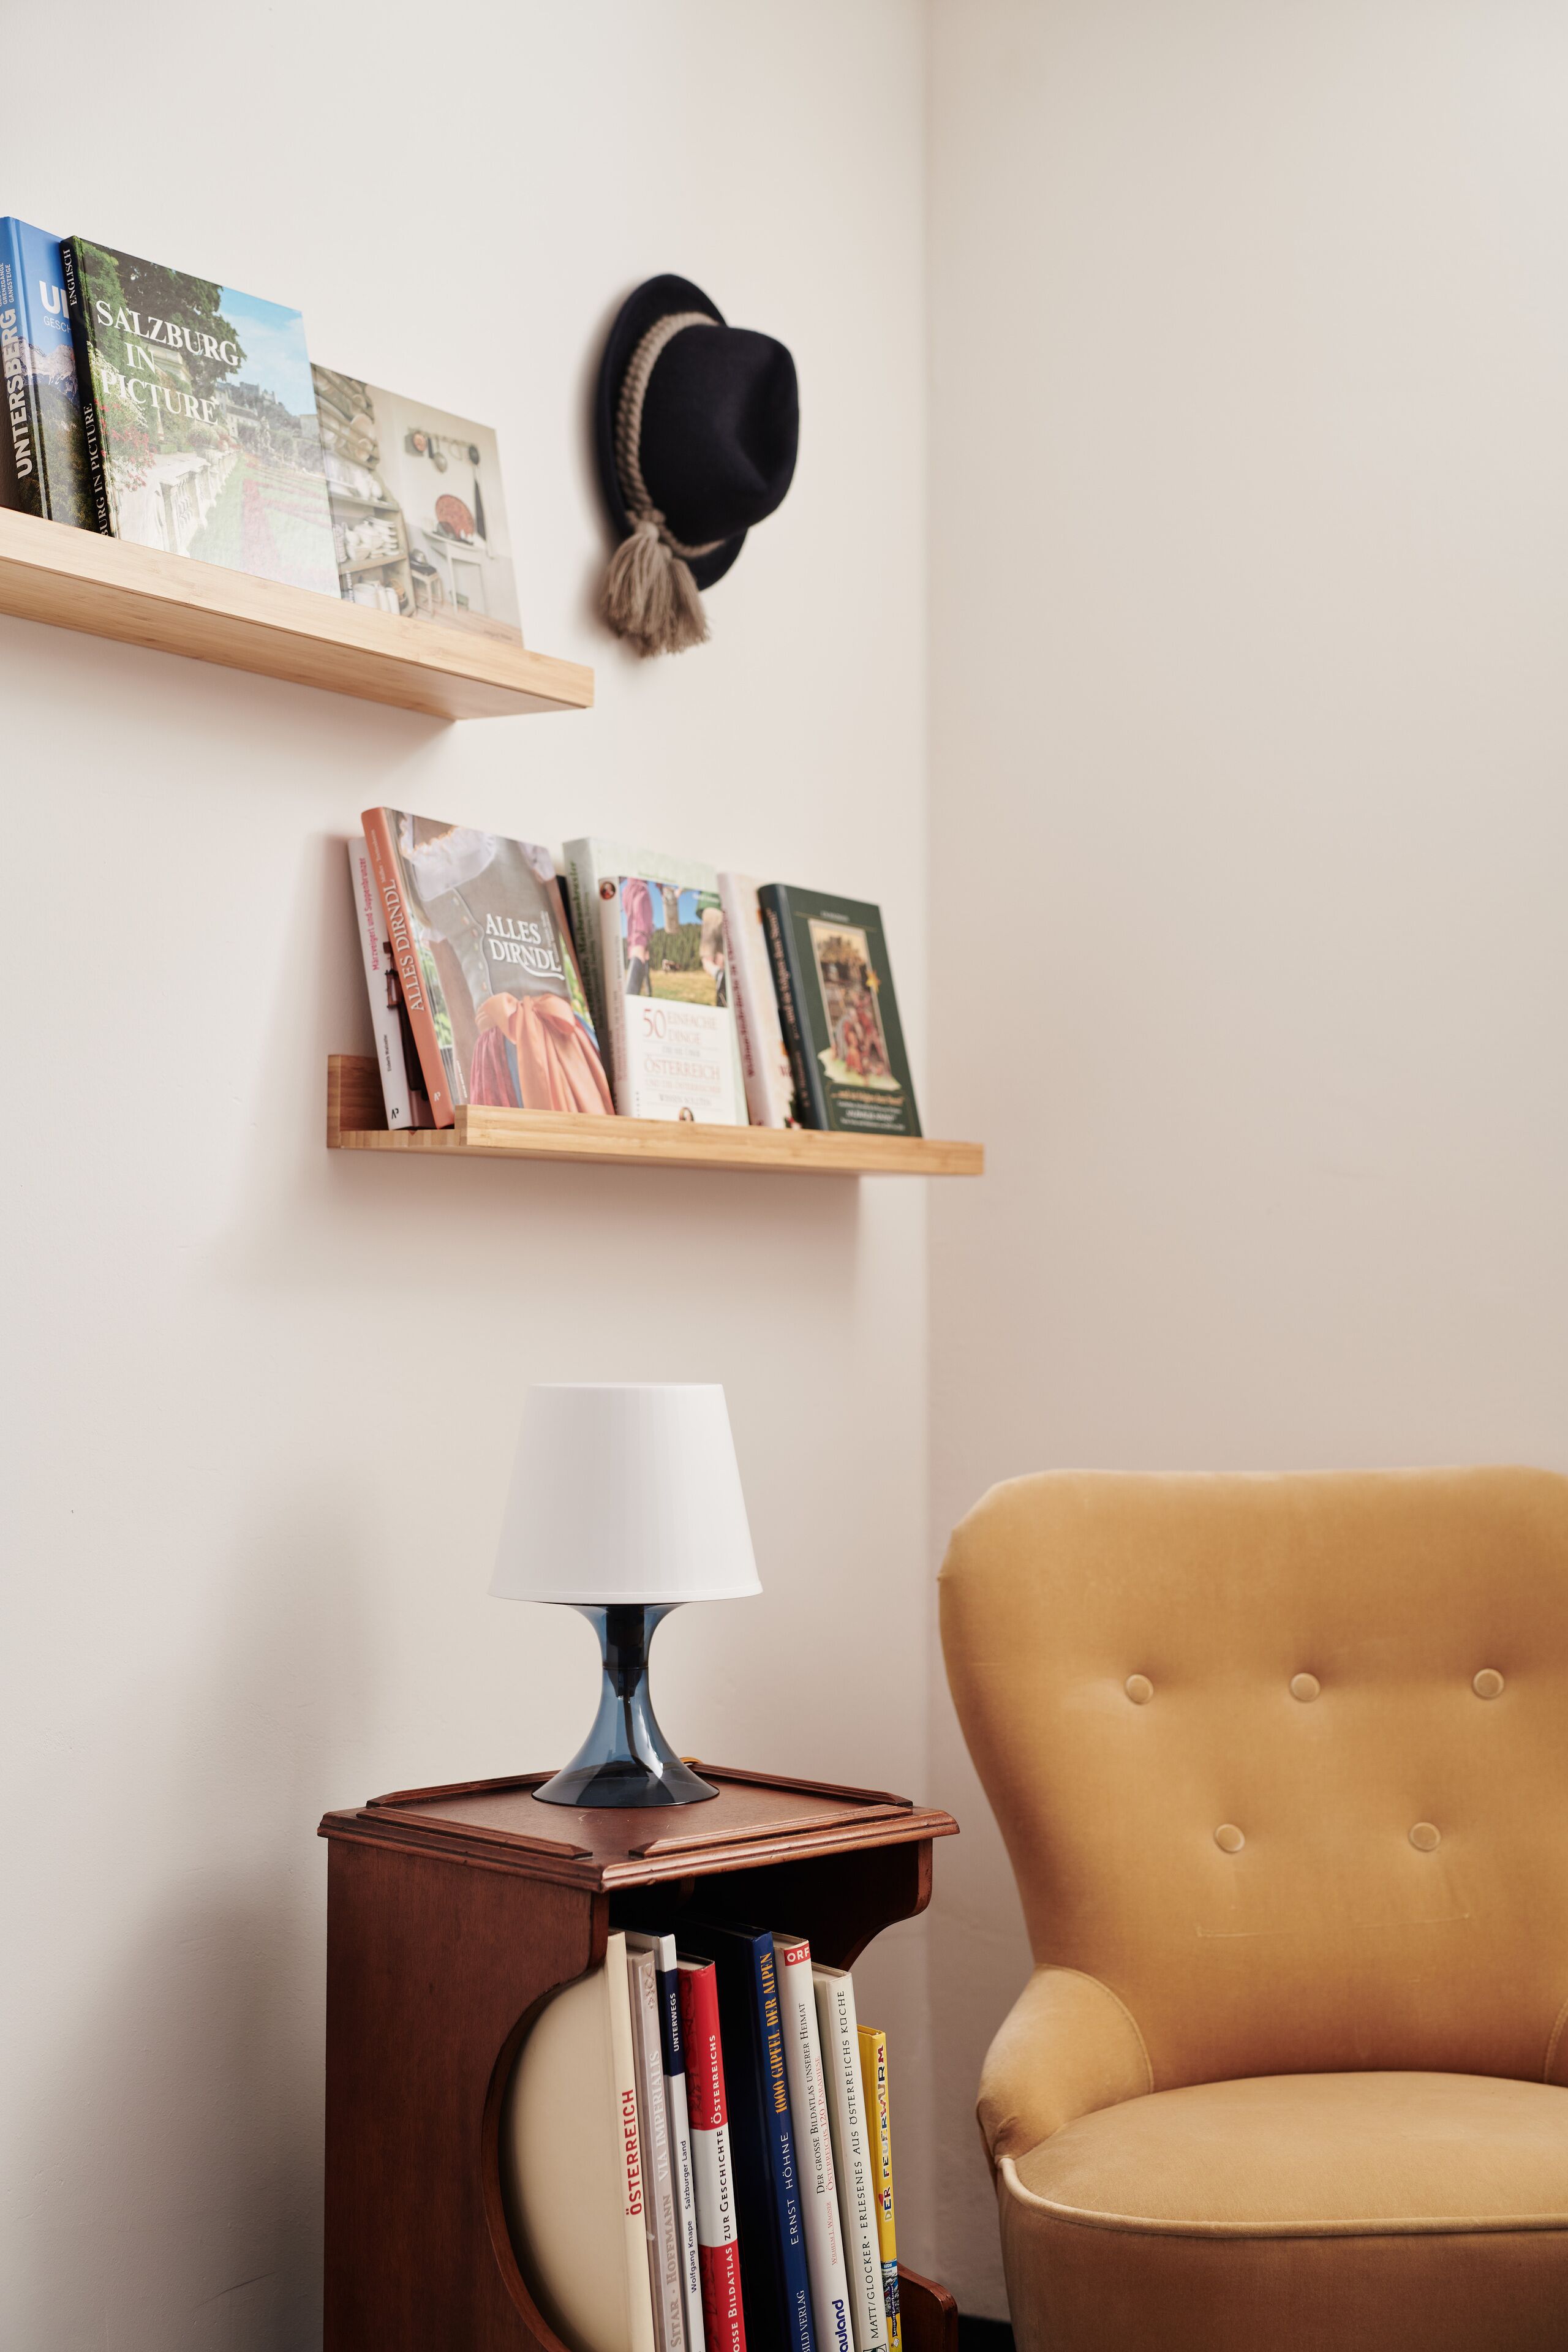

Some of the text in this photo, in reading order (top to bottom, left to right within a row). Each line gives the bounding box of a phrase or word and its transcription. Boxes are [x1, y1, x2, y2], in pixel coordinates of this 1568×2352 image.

[6, 264, 15, 303] GANGSTEIGE
[64, 249, 77, 306] ENGLISCH
[96, 300, 239, 366] SALZBURG
[124, 342, 156, 374] IN
[1, 308, 32, 480] UNTERSBERG
[100, 369, 219, 426] PICTURE
[83, 403, 100, 472] PICTURE
[92, 474, 104, 494] IN
[383, 879, 425, 1011] ALLES DIRNDL
[486, 913, 541, 945] ALLES
[488, 938, 565, 980] DIRNDL
[644, 1009, 666, 1039] 50
[644, 1053, 722, 1080] ÖSTERREICH
[786, 1947, 810, 1963] ORF
[670, 1992, 679, 2052] UNTERWEGS
[760, 1952, 788, 2114] 1000 GIPFEL DER ALPEN
[709, 2035, 722, 2124] ÖSTERREICHS
[799, 2003, 825, 2195] DER GROSSE BILDATLAS UNSERER HEIMAT
[815, 2056, 825, 2106] PARADIESE
[649, 2050, 669, 2181] VIA IMPERIALIS
[878, 2045, 892, 2221] DER FEUERWURM
[622, 2089, 642, 2215] ÖSTERREICH
[717, 2130, 729, 2212] GESCHICHTE
[823, 2128, 834, 2191] ÖSTERREICHS
[837, 1991, 878, 2340] MATT/GLOCKER ERLESENES AUS ÖSTERREICHS KÜCHE
[682, 2164, 691, 2209] Salzburger
[780, 2132, 799, 2245] ERNST HÖHNE
[723, 2215, 731, 2241] ZUR
[663, 2194, 682, 2348] SITAR HOFFMANN
[725, 2247, 737, 2318] BILDATLAS
[796, 2290, 809, 2332] VERLAG
